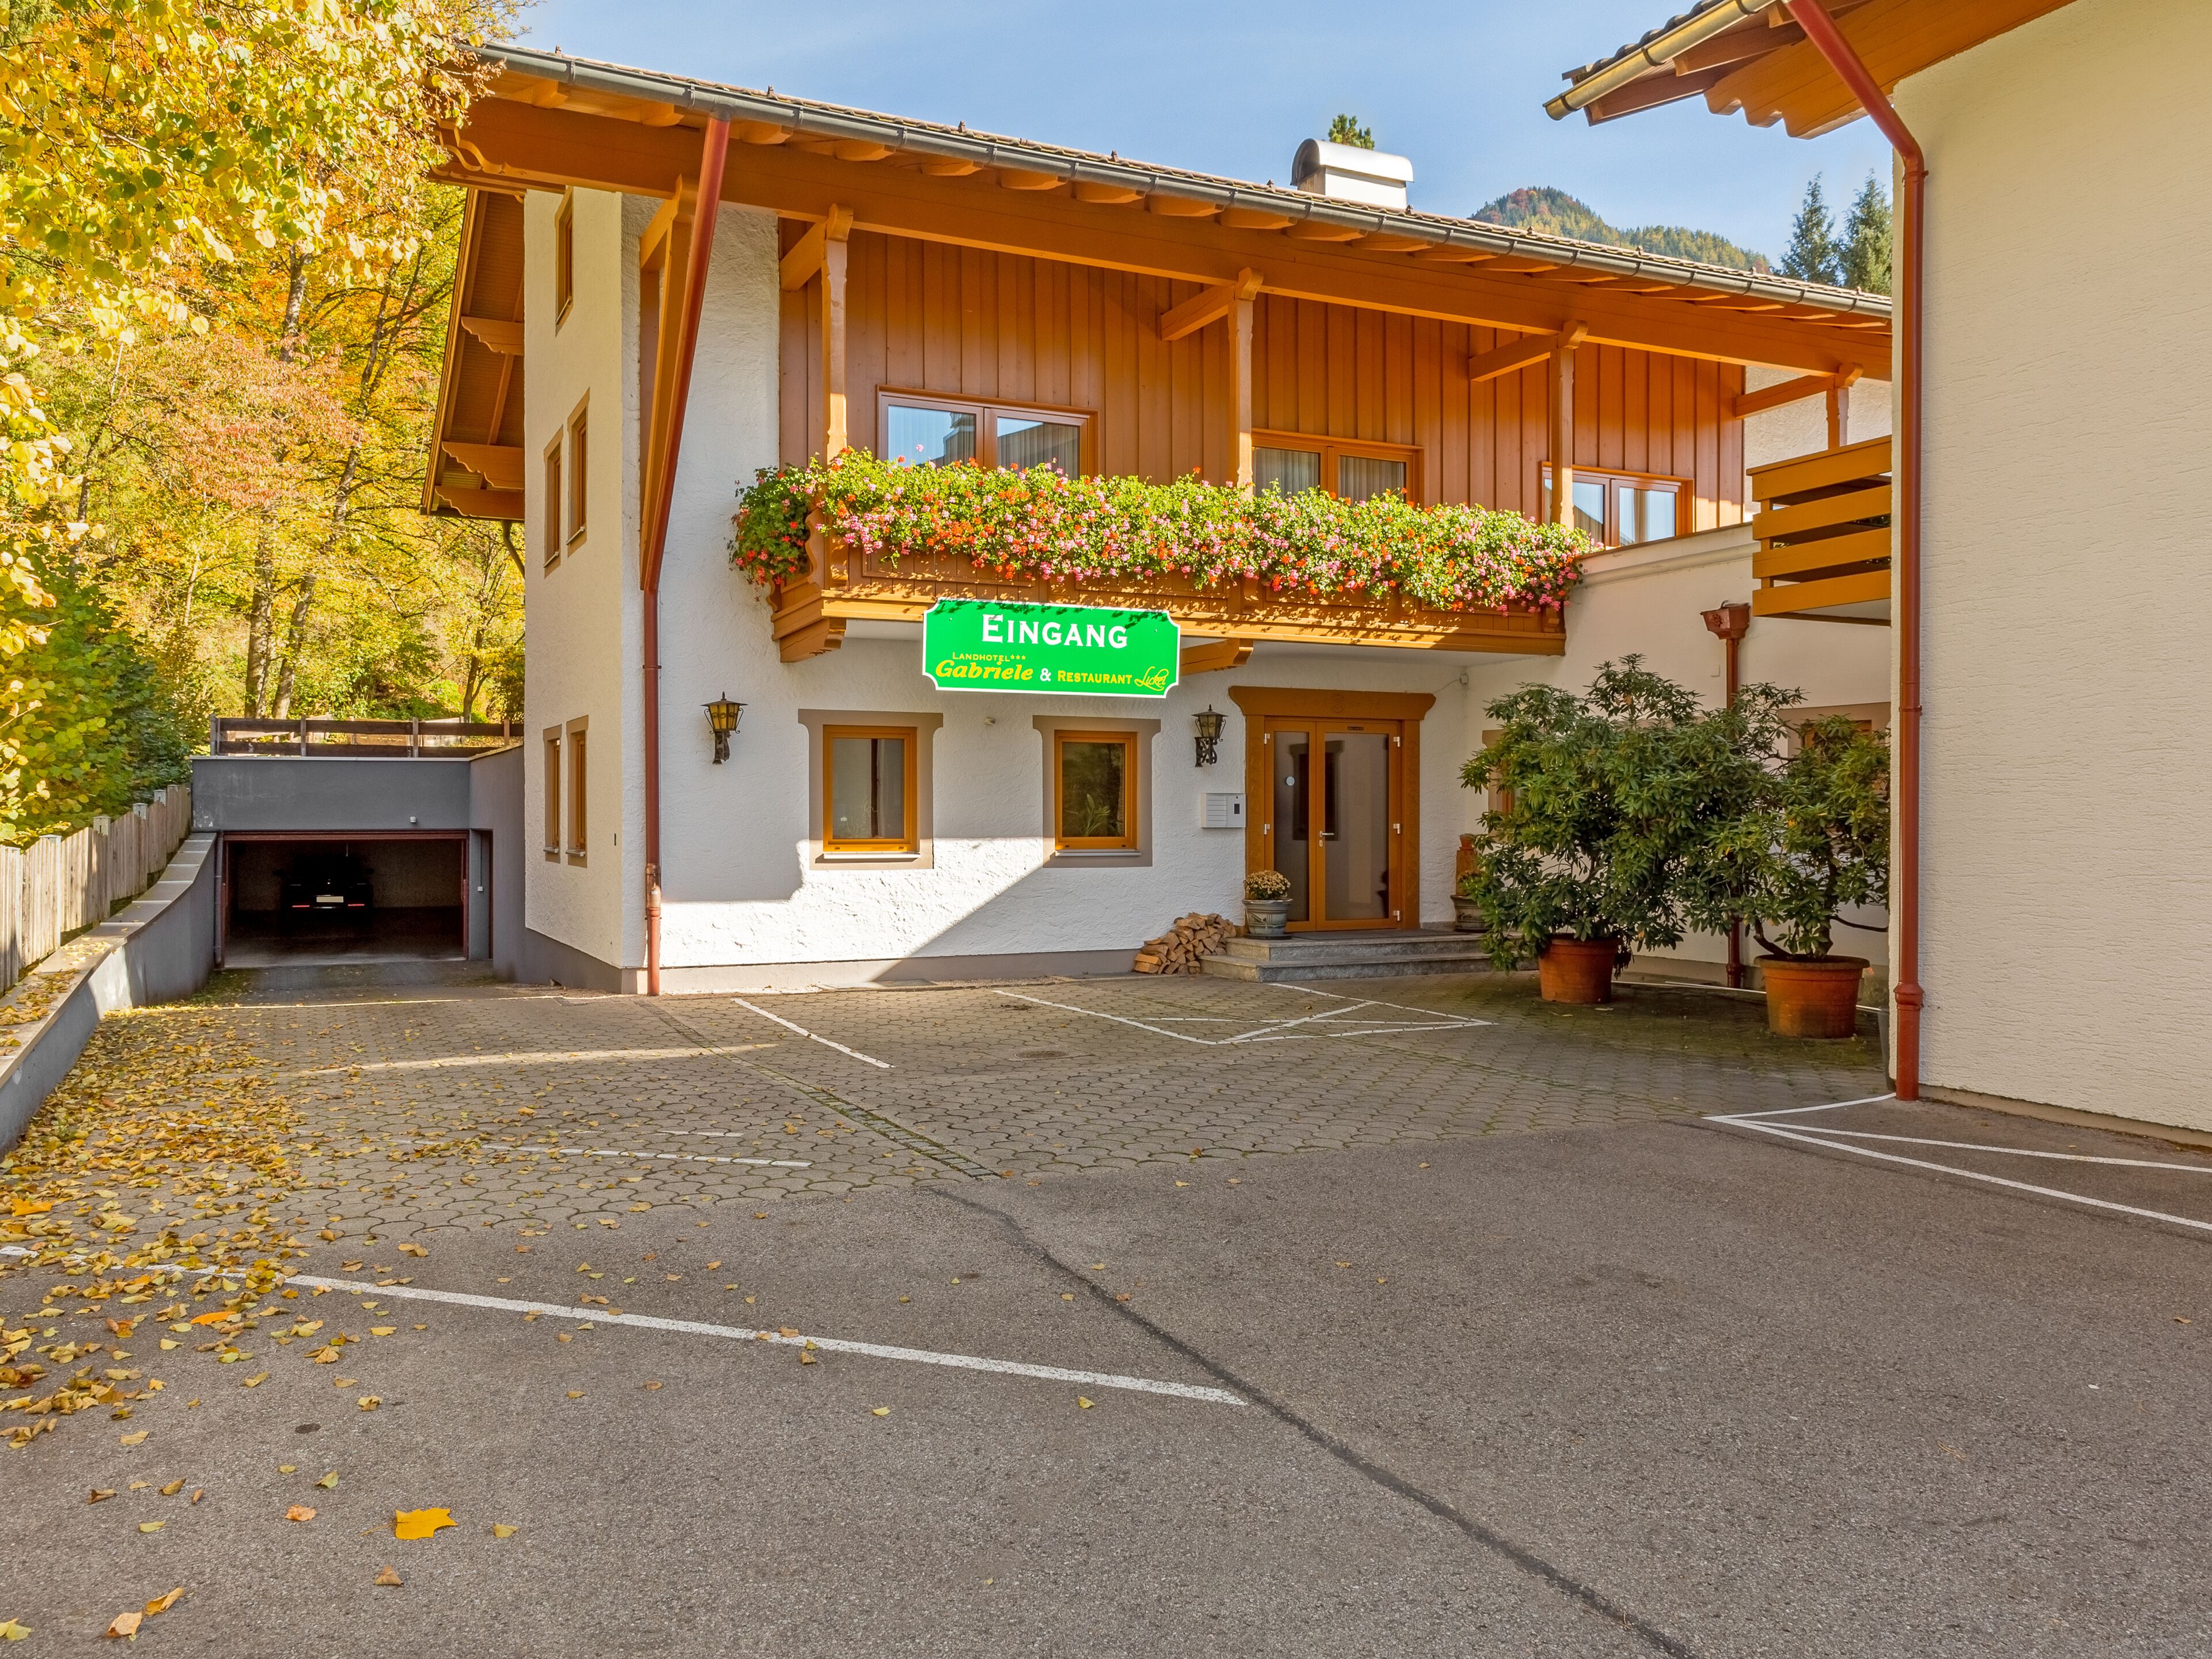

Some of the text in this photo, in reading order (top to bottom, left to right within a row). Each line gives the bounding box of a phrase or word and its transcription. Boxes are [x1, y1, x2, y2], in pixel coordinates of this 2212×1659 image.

[982, 613, 1128, 649] EINGANG
[935, 660, 1033, 681] Gabriele
[1040, 668, 1051, 682] &
[1058, 670, 1132, 684] RESTAURANT
